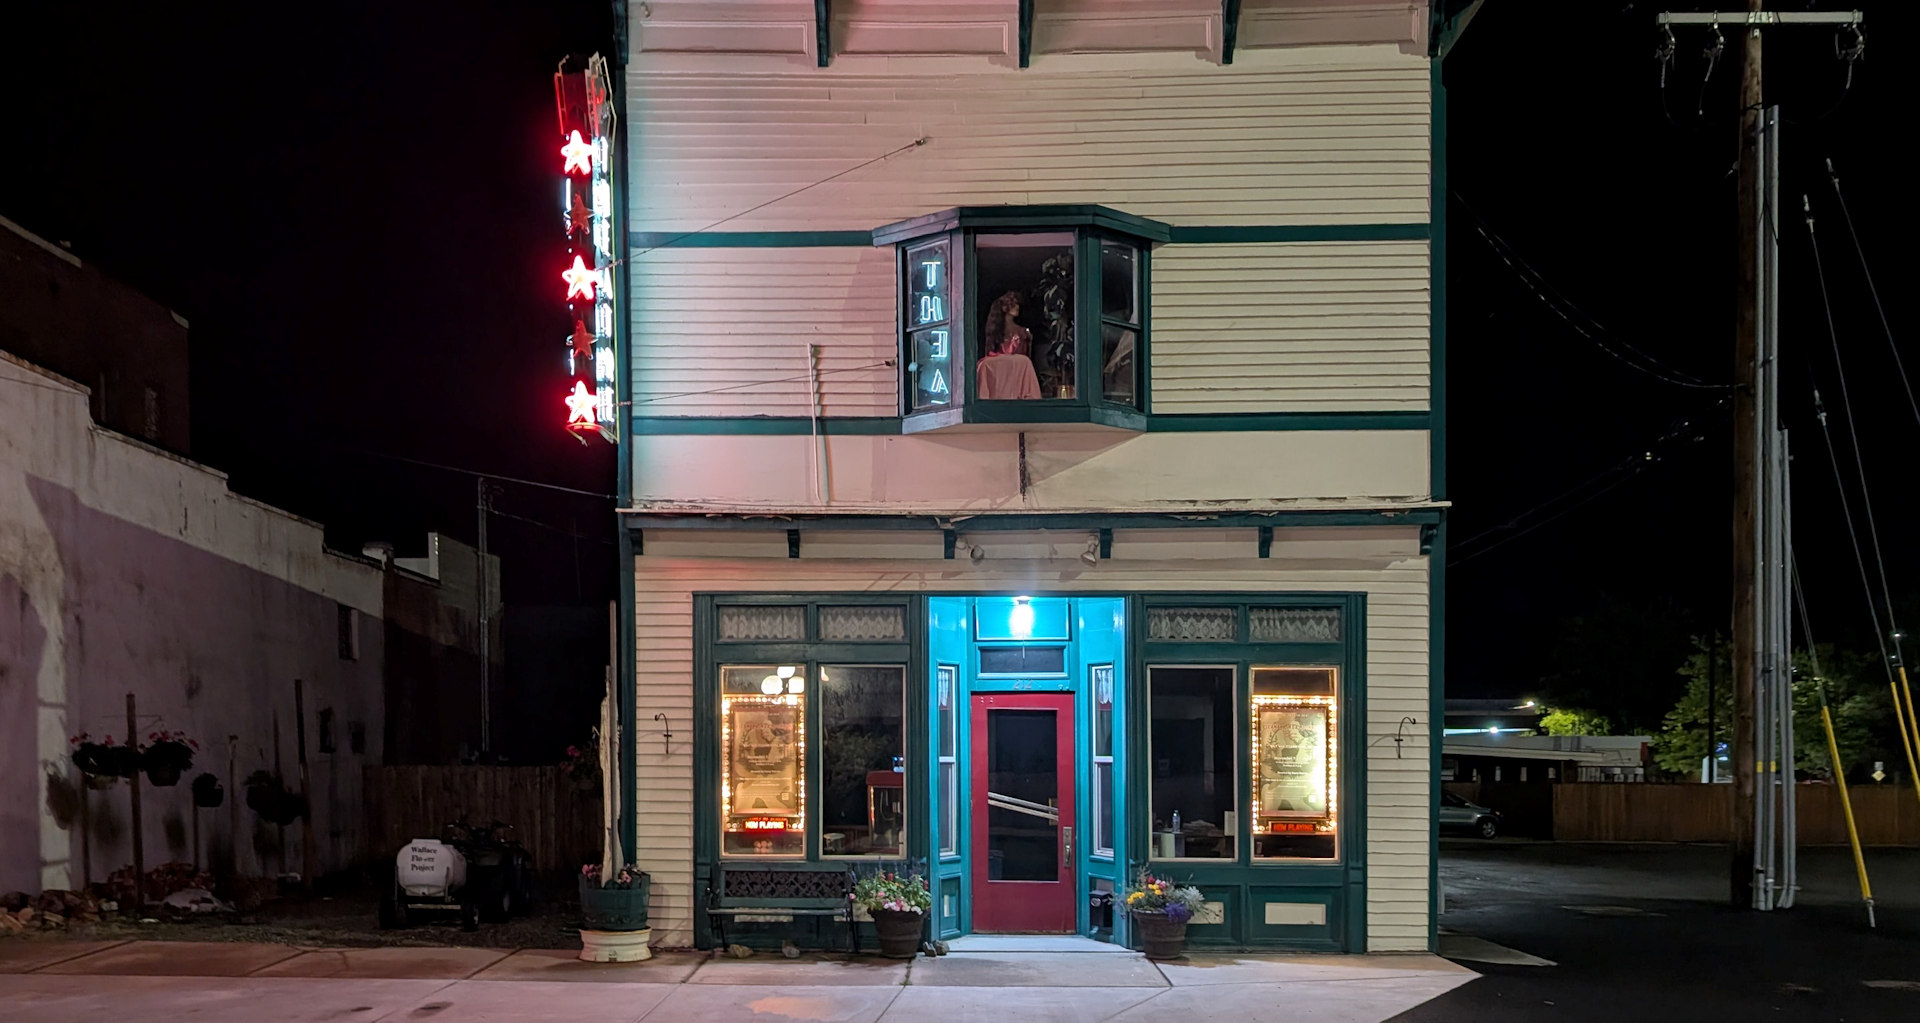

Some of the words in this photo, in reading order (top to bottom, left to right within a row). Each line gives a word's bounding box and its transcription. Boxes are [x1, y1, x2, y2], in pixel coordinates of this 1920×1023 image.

[745, 821, 758, 829] NOW
[759, 821, 784, 829] PLAYING
[1273, 823, 1287, 832] NOW
[1288, 823, 1314, 832] PLAYING
[411, 846, 437, 854] Wallace
[411, 864, 435, 872] Project
